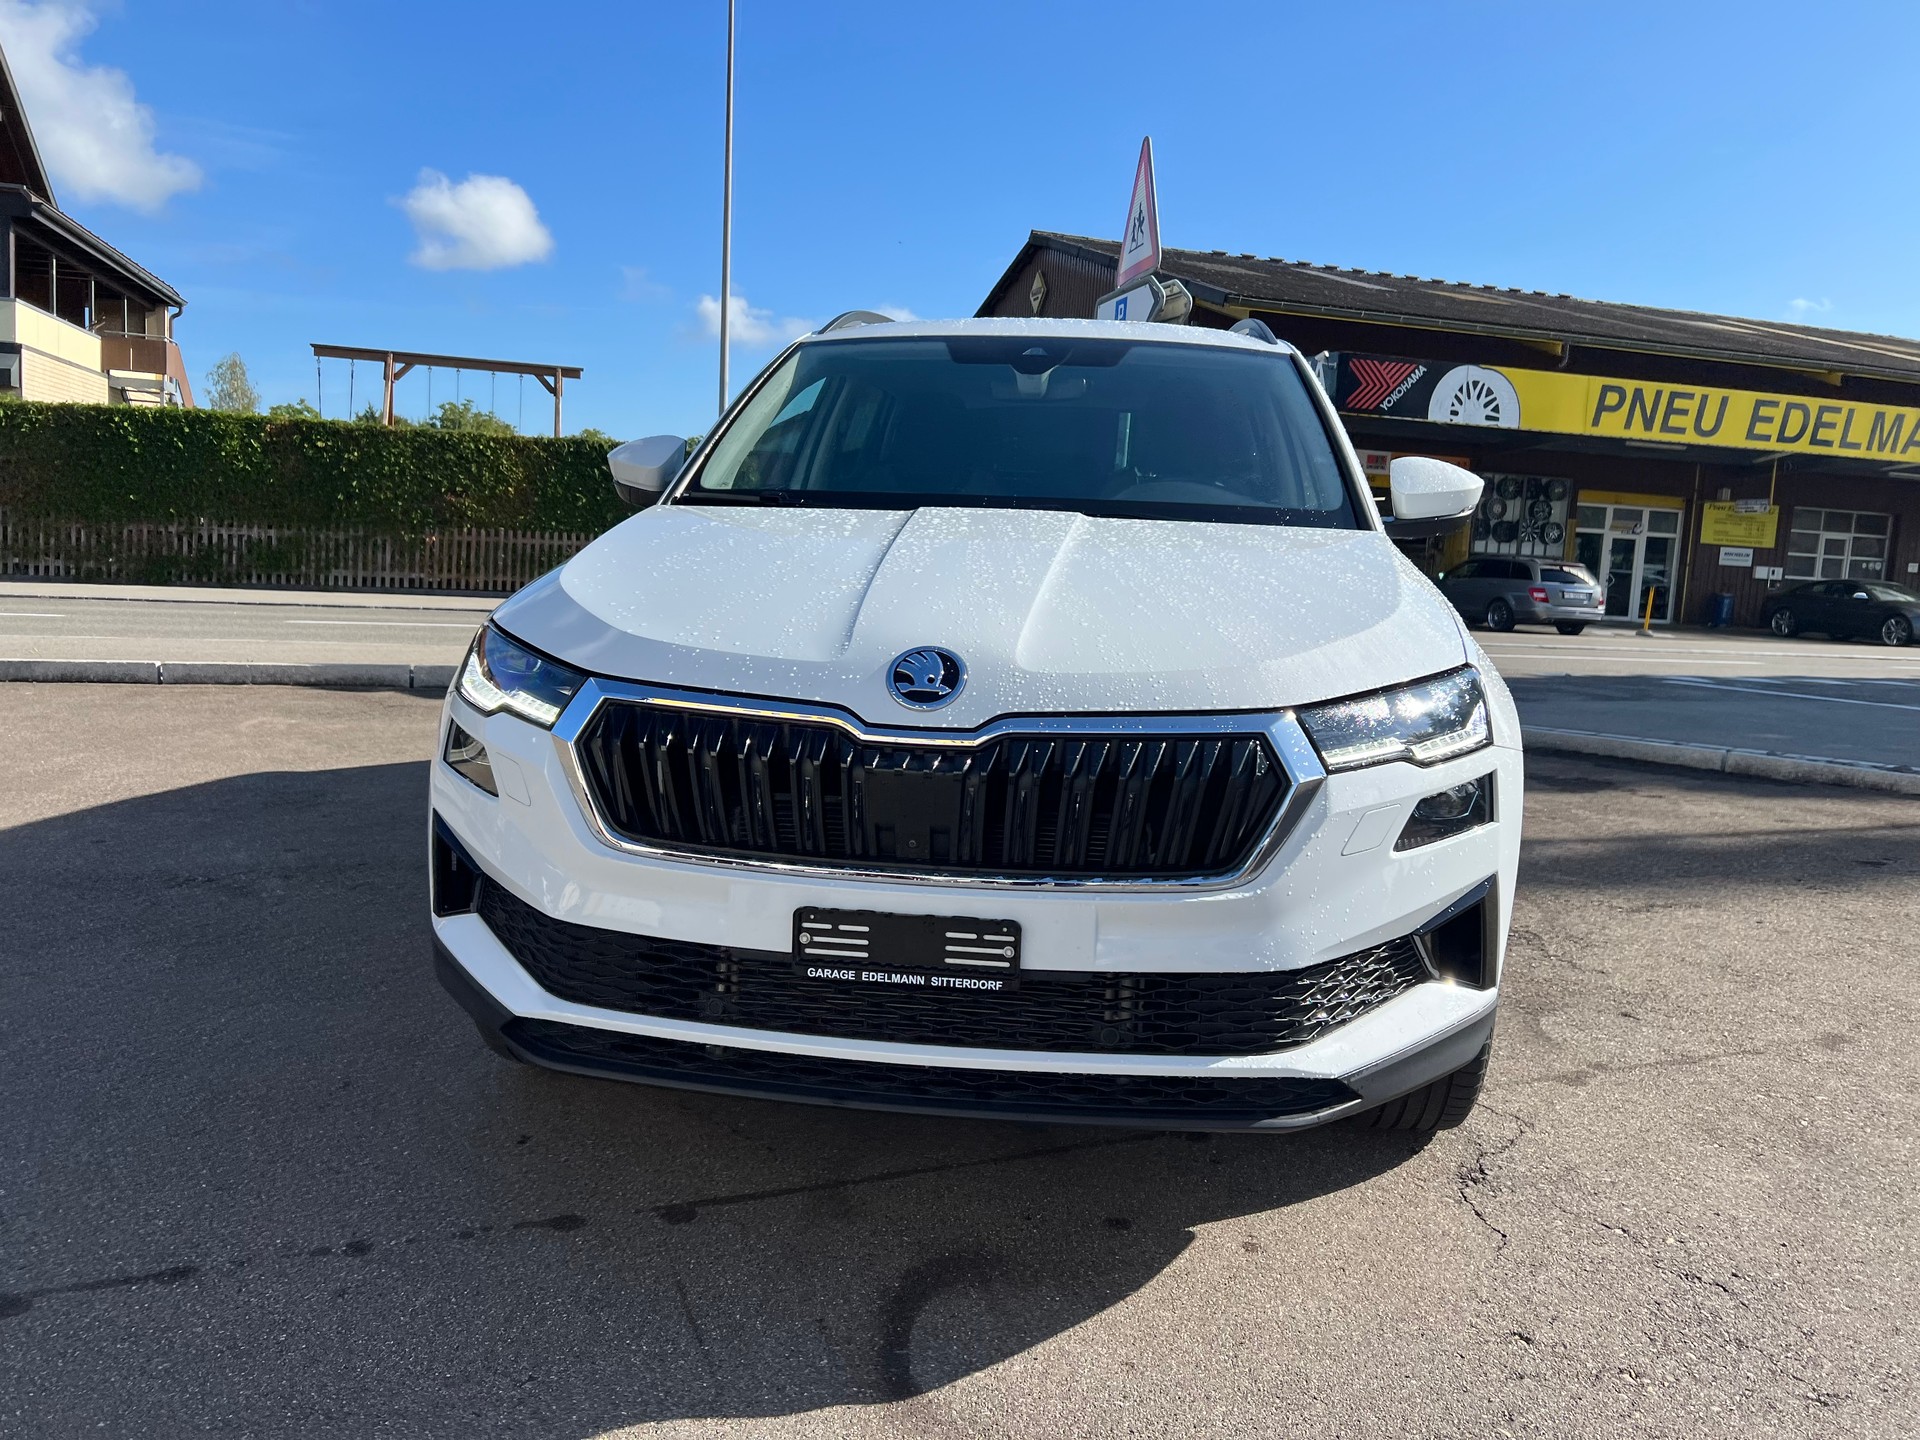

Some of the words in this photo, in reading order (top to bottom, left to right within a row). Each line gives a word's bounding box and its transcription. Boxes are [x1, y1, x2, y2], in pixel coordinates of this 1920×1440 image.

[1118, 303, 1125, 320] P
[1380, 365, 1427, 411] YOKOHAMA
[1591, 384, 1730, 438] PNEU
[807, 967, 856, 980] GARAGE
[861, 971, 925, 985] EDELMANN
[930, 976, 1003, 991] SITTERDORF
